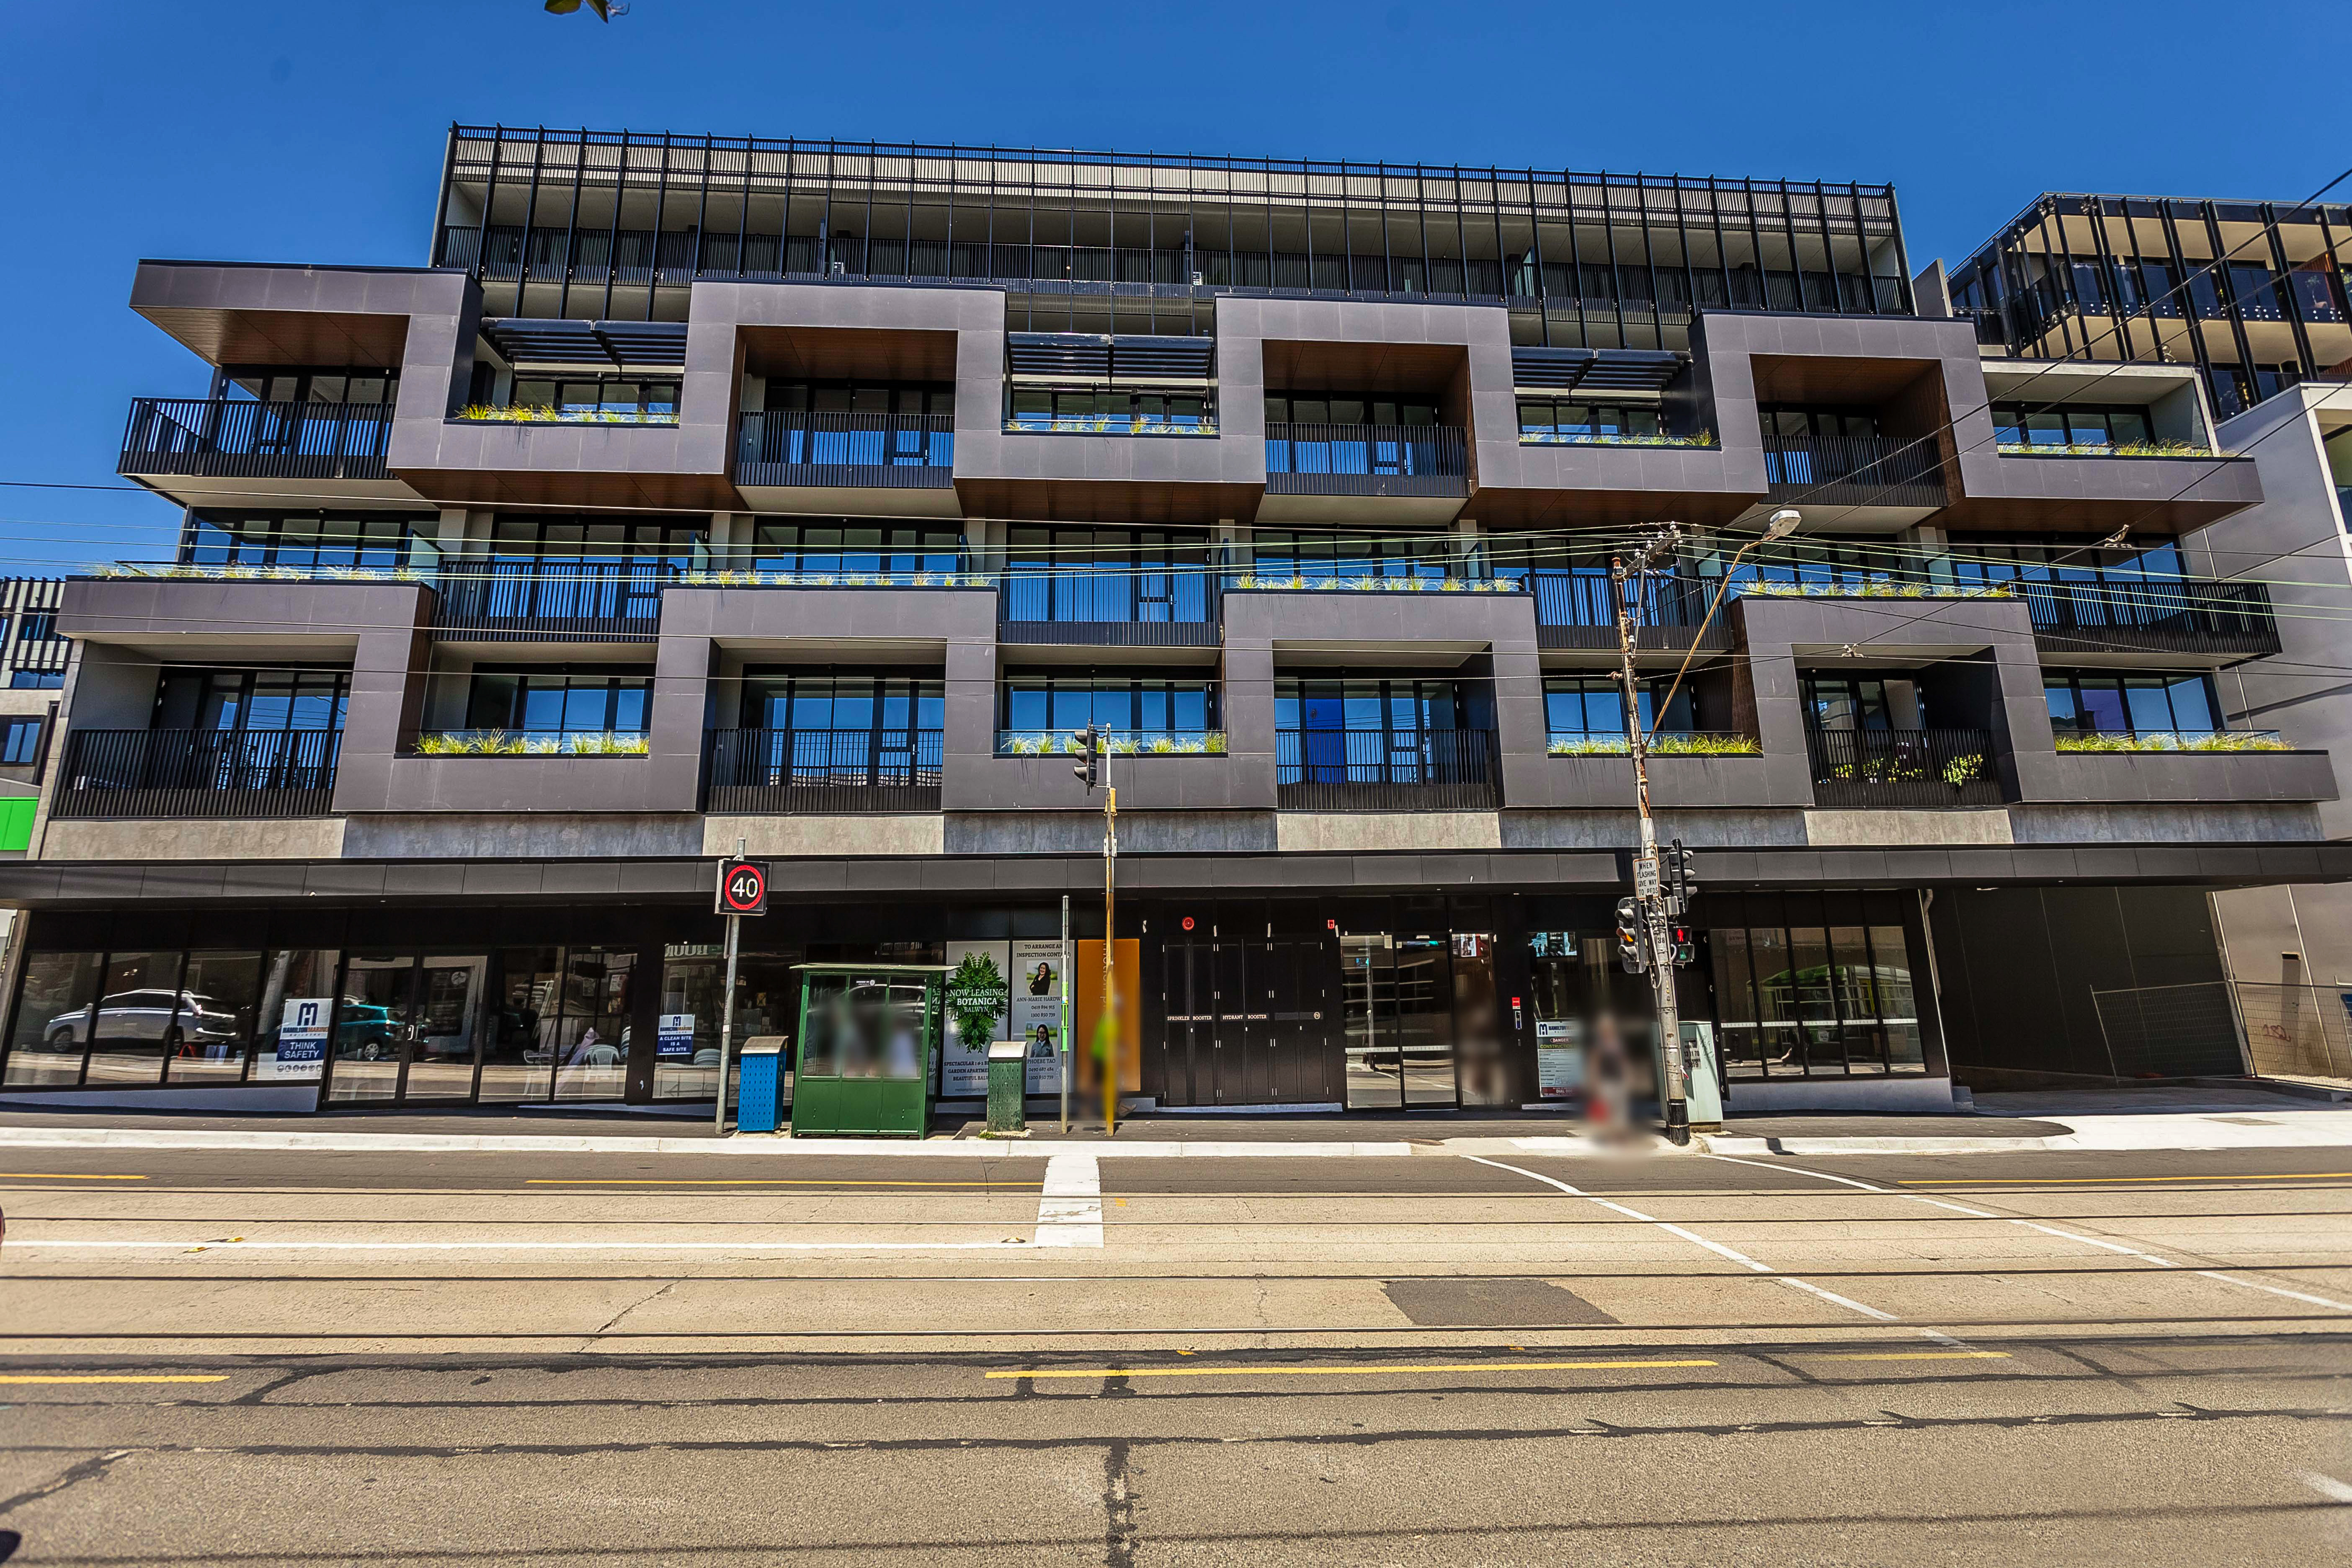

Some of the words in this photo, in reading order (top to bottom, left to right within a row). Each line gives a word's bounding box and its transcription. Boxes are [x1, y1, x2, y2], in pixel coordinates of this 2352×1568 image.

[1637, 870, 1656, 879] FLASHING
[731, 877, 758, 897] 40
[284, 1050, 320, 1059] SAFETY
